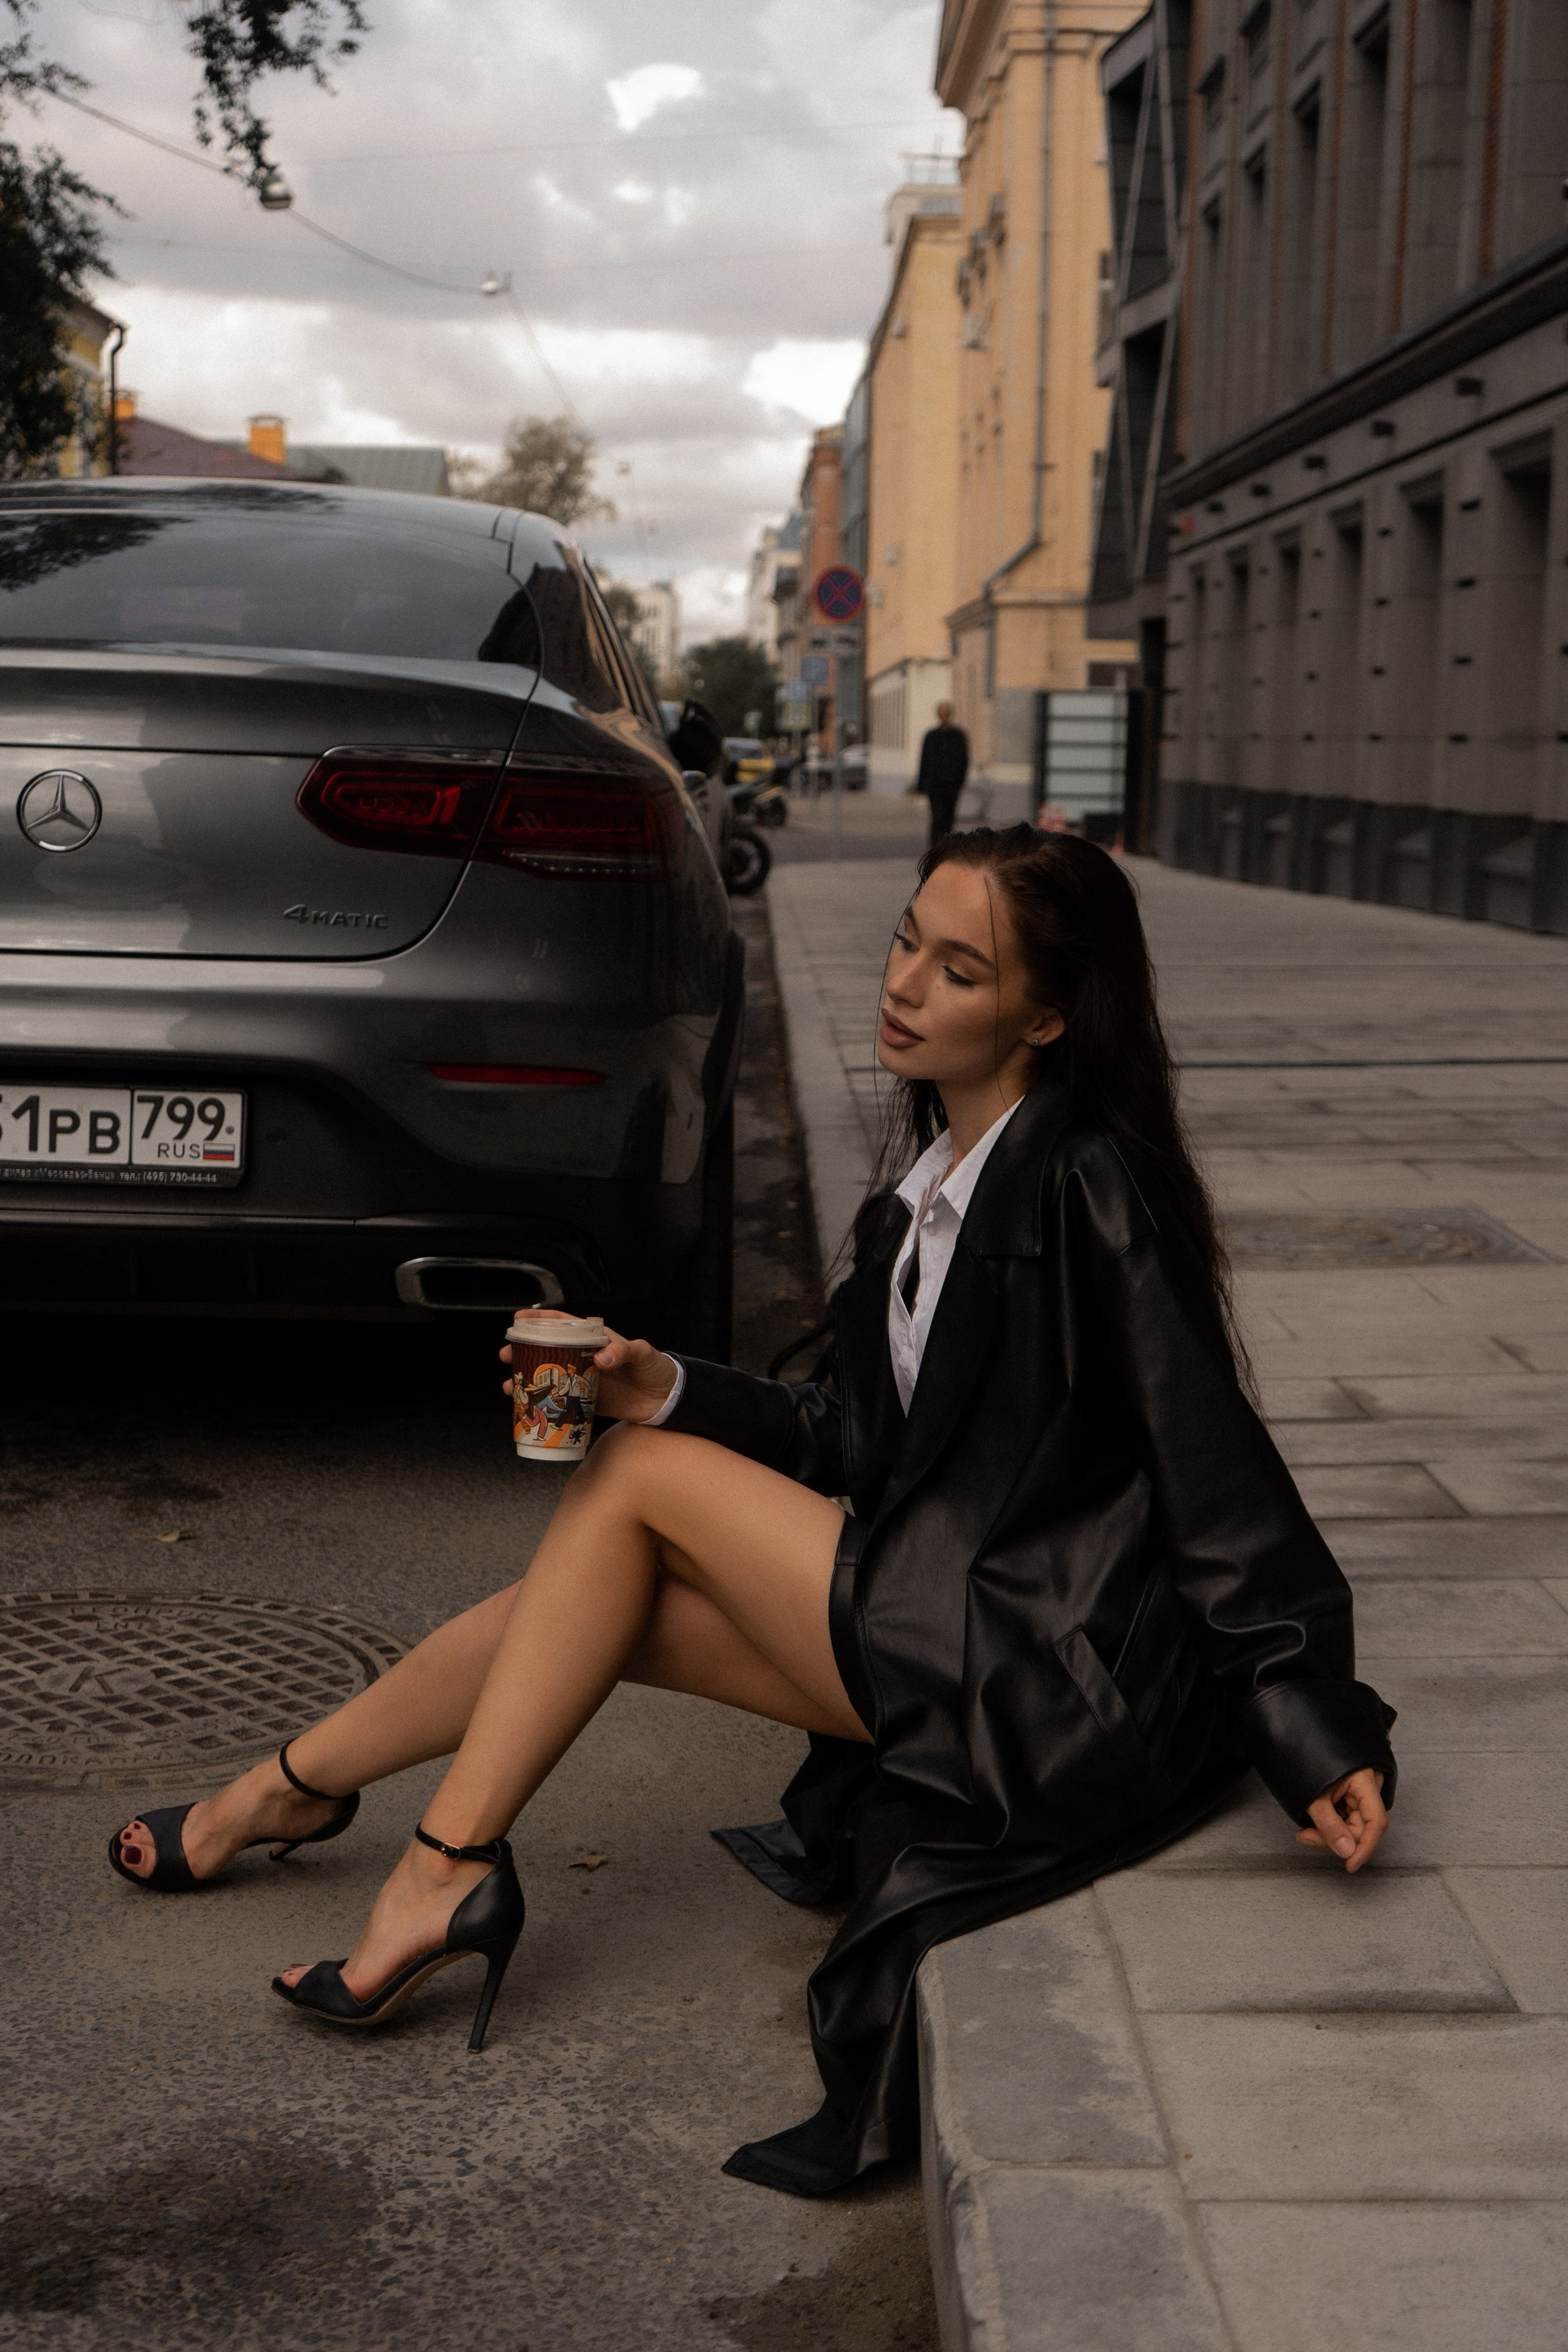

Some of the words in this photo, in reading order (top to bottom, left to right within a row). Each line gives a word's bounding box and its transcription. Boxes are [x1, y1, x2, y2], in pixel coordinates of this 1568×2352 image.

[283, 903, 388, 929] 4MATIC
[0, 1093, 121, 1154] 1РВ
[137, 1095, 225, 1141] 799
[157, 1142, 201, 1158] RUS
[143, 1171, 167, 1183] (495)
